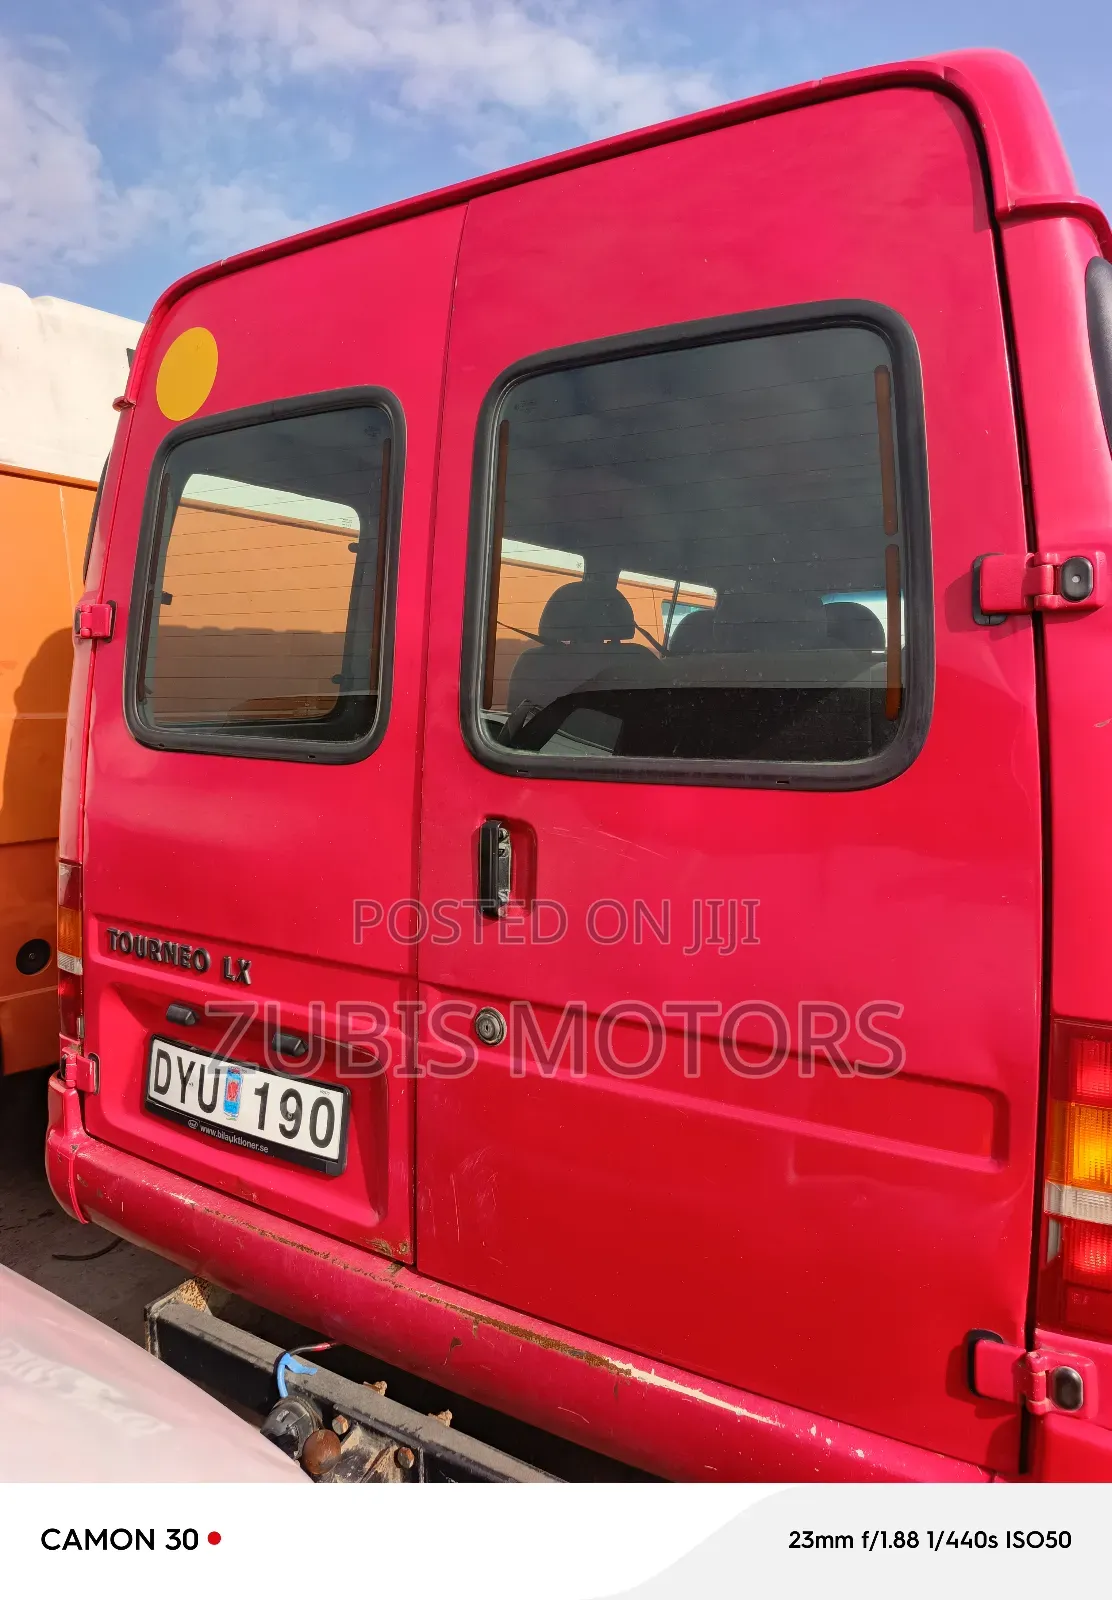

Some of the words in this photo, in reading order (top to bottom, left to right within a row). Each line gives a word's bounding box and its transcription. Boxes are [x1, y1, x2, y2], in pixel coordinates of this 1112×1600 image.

[106, 927, 211, 973] TOURNEO
[223, 955, 252, 985] LX
[153, 1048, 221, 1114] DYU
[254, 1081, 336, 1149] 190
[200, 1125, 269, 1153] www.bilauktioner.se
